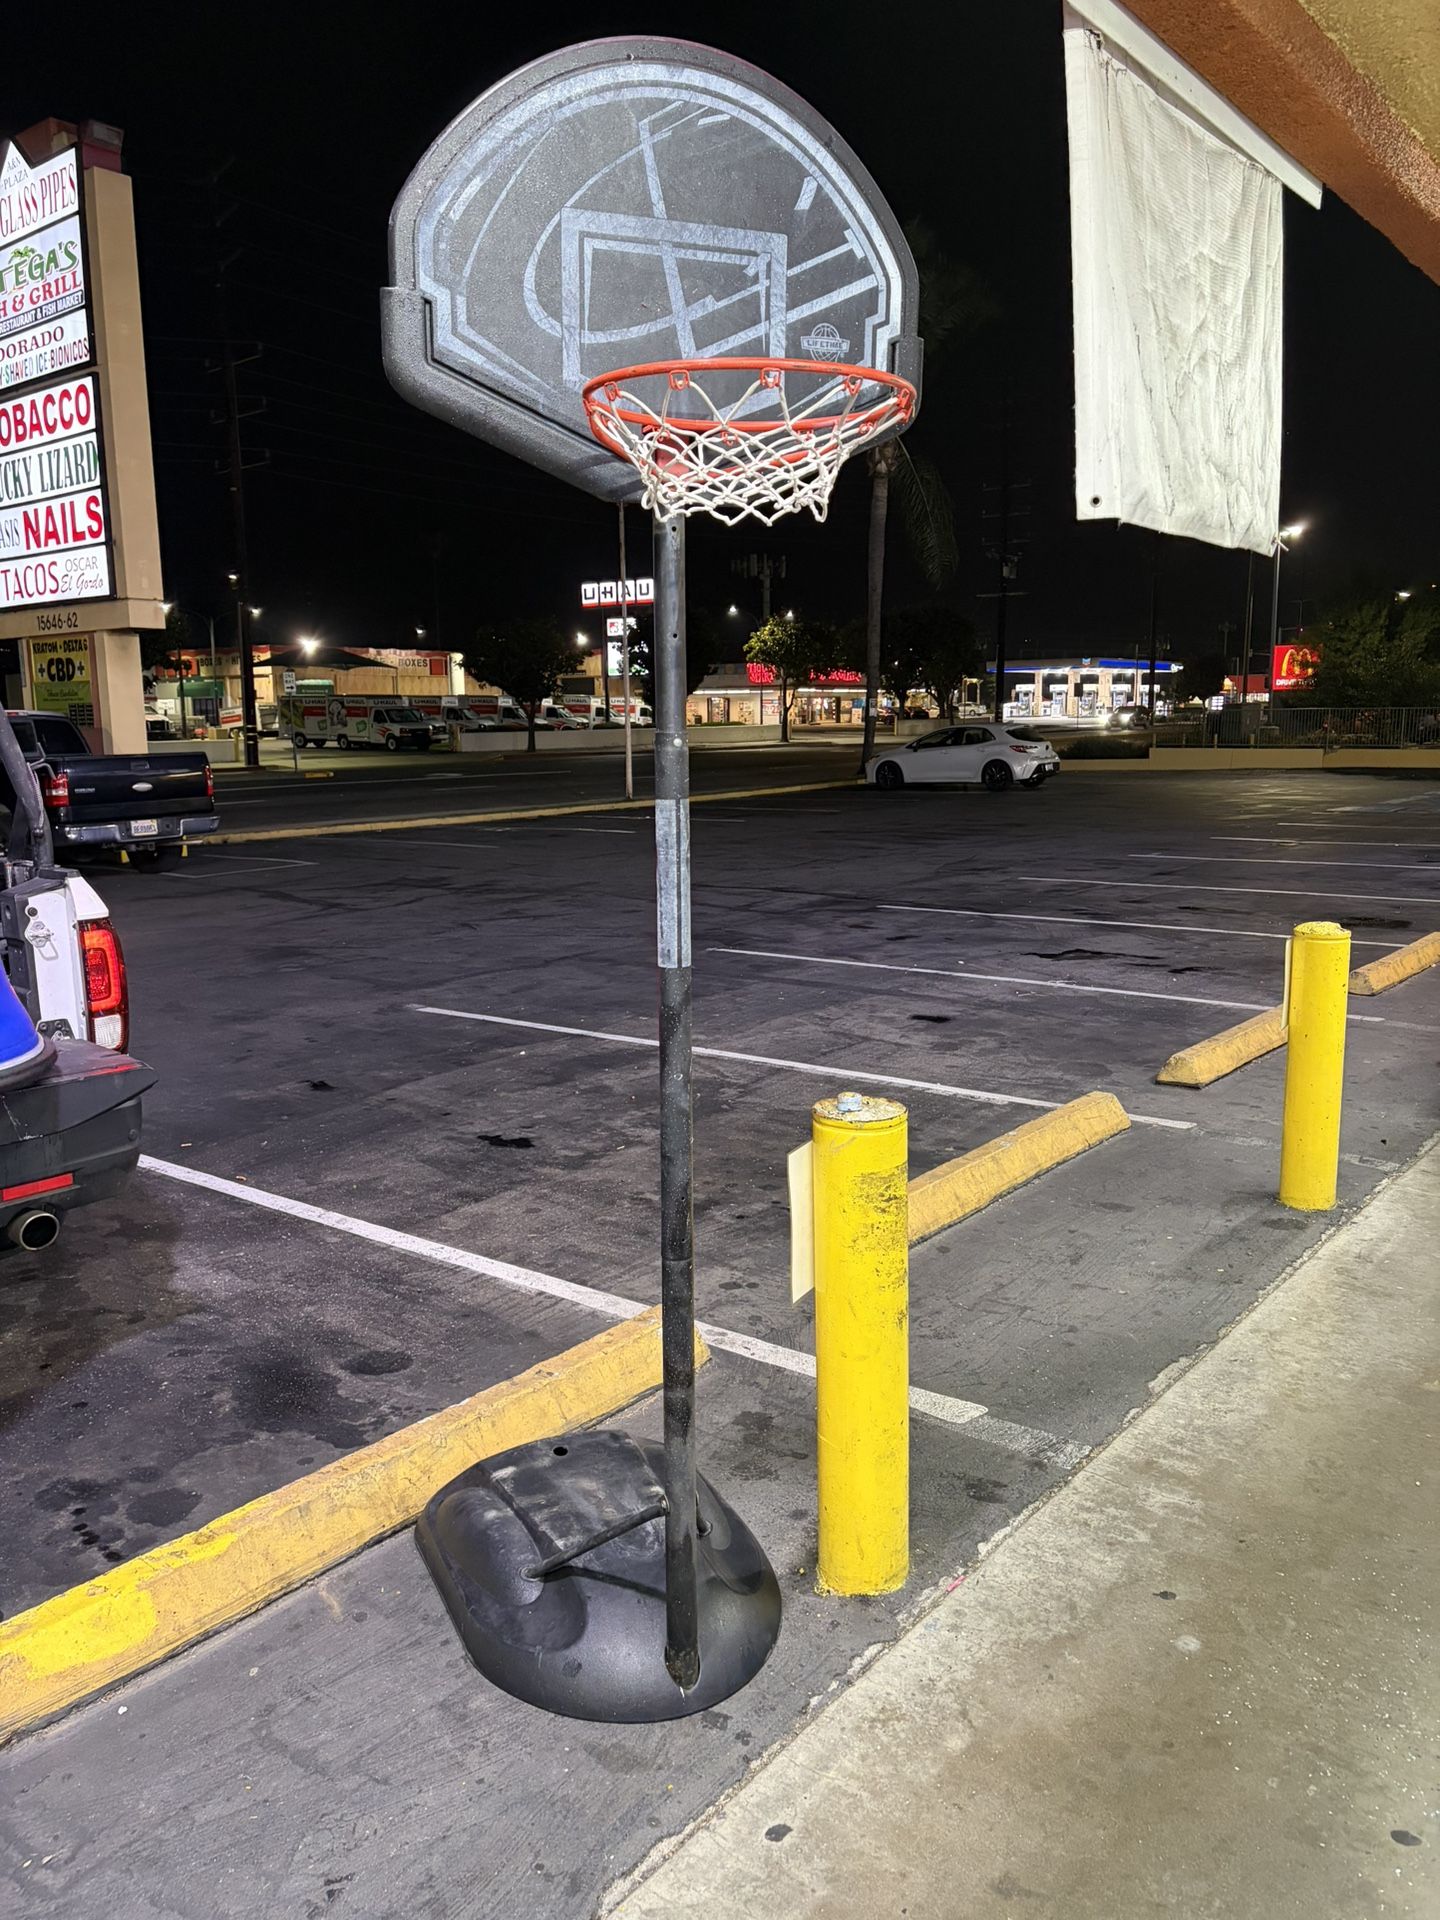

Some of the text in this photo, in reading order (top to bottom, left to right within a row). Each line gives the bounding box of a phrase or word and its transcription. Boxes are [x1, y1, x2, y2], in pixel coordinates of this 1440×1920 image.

[3, 169, 28, 190] PLAZA
[0, 163, 76, 237] GLASS PIPES
[12, 294, 24, 313] &
[29, 271, 82, 306] GRILL
[42, 300, 56, 319] FISH
[57, 291, 83, 313] MARKET
[807, 339, 843, 349] LIFETIME
[0, 384, 91, 447] OBACCO
[37, 440, 99, 493] LIZARD
[22, 495, 103, 551] NAILS
[65, 556, 98, 573] OSCAR
[1, 561, 60, 601] TACOS
[61, 574, 72, 593] El
[32, 641, 59, 654] KRATOM
[46, 657, 76, 682] CBD
[398, 658, 428, 668] BOXES
